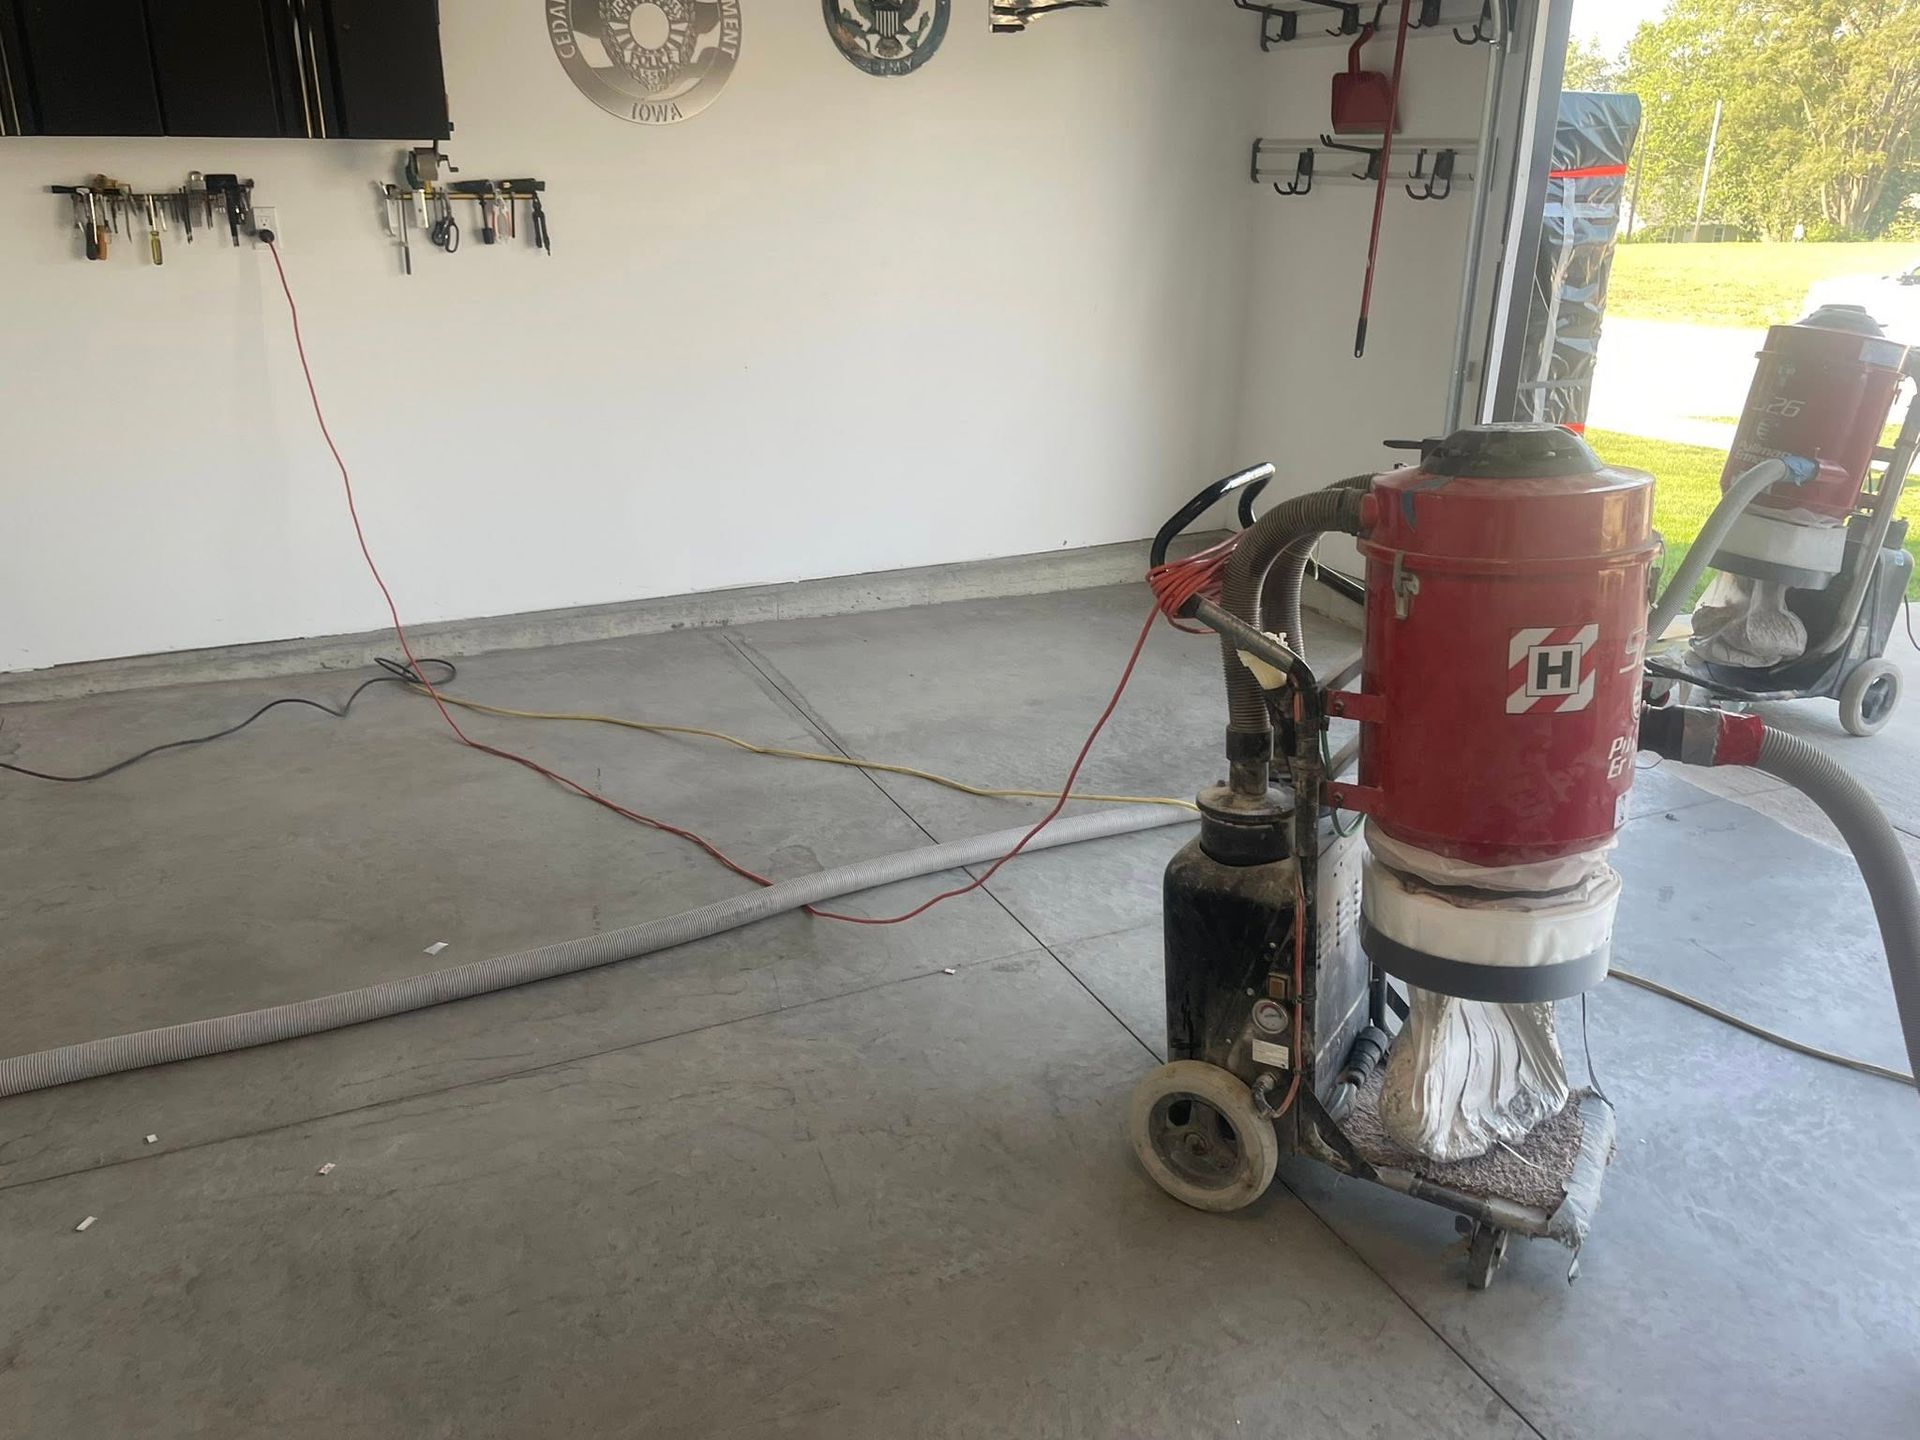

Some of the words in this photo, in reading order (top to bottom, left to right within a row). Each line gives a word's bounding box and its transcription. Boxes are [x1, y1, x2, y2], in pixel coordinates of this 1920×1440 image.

[549, 0, 576, 59] CEDA
[632, 102, 683, 122] IOWA
[1536, 650, 1573, 690] H
